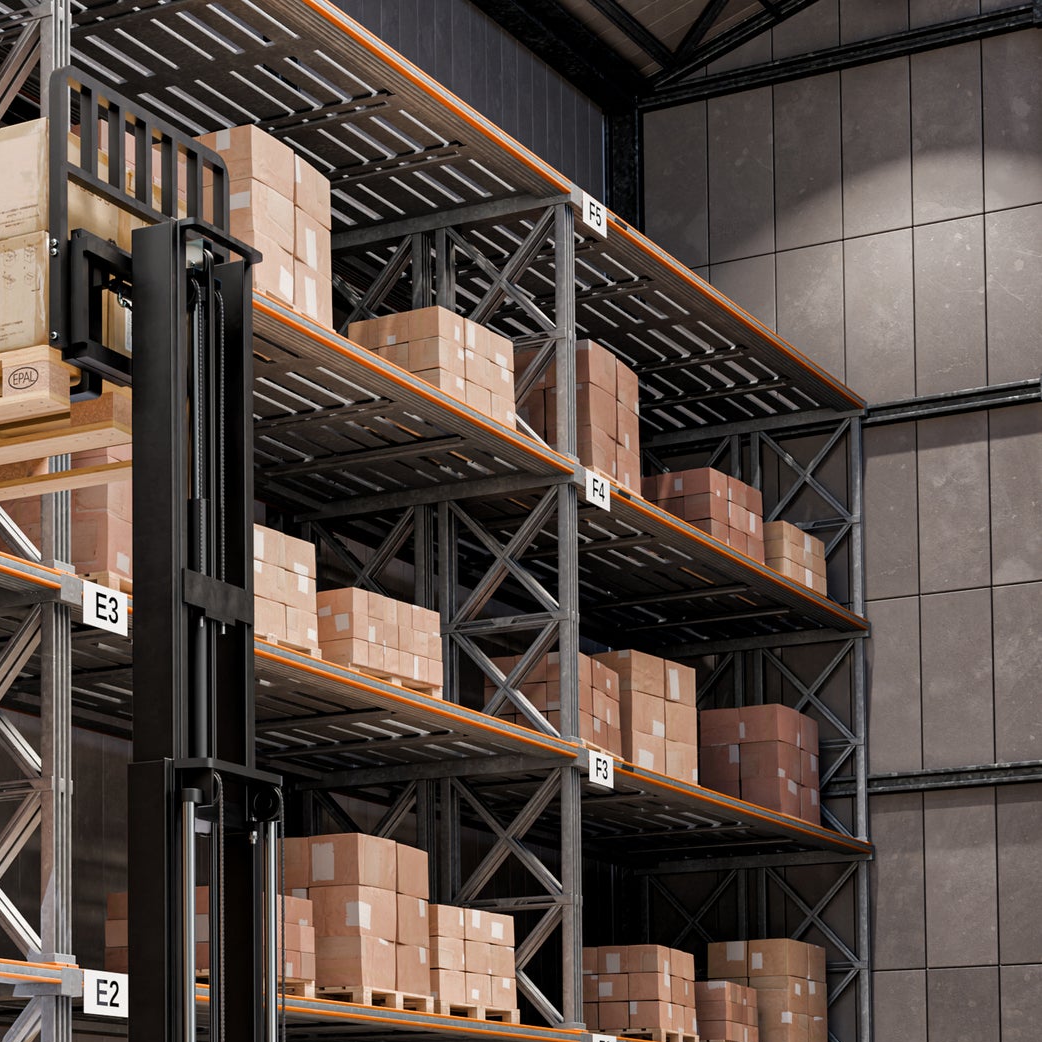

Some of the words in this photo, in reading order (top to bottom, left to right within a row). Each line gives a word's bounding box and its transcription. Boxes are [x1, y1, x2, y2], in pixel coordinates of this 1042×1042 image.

[589, 201, 602, 227] F5
[13, 370, 35, 386] EPAL
[592, 477, 605, 502] F4
[96, 591, 119, 624] E3
[596, 757, 608, 781] F3
[96, 978, 120, 1008] E2
